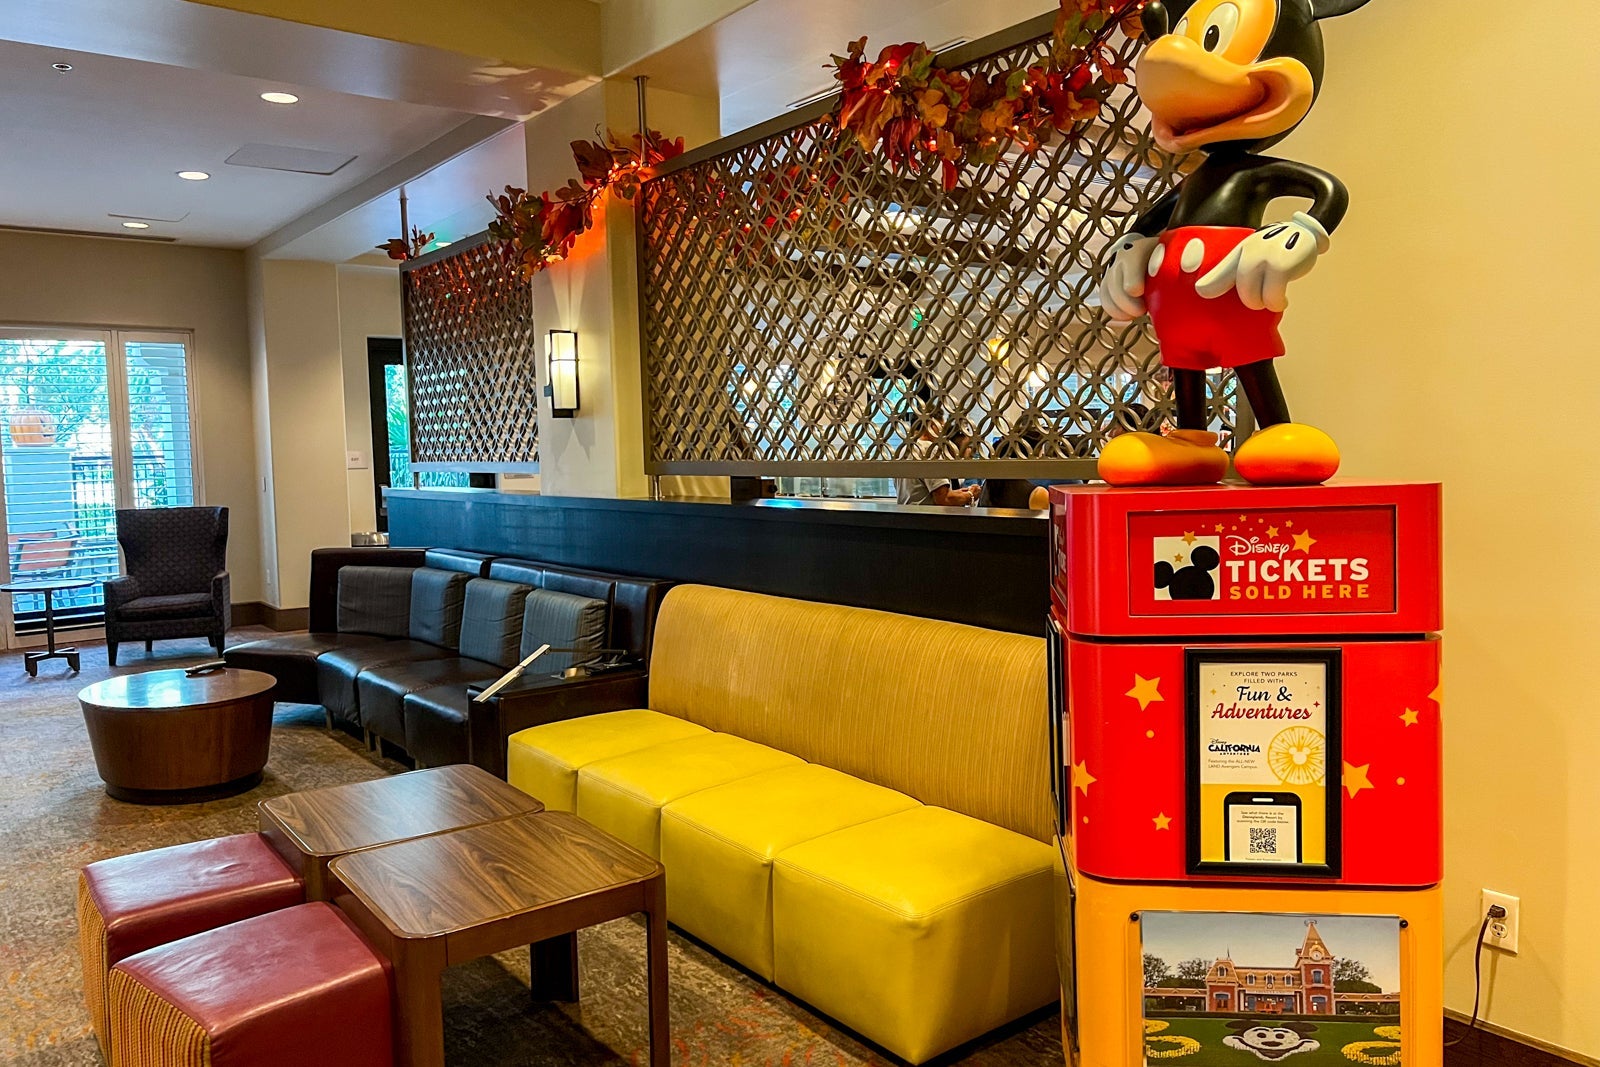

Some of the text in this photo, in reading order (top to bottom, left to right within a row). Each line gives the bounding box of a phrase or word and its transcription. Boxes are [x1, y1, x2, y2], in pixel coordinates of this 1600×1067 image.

[1225, 535, 1290, 560] Disney
[1225, 558, 1369, 583] TICKETS
[1229, 584, 1369, 600] SOLD HERE
[1236, 685, 1293, 702] Fun &
[1211, 702, 1312, 719] Adventures
[1208, 744, 1260, 752] CALIFORNIA
